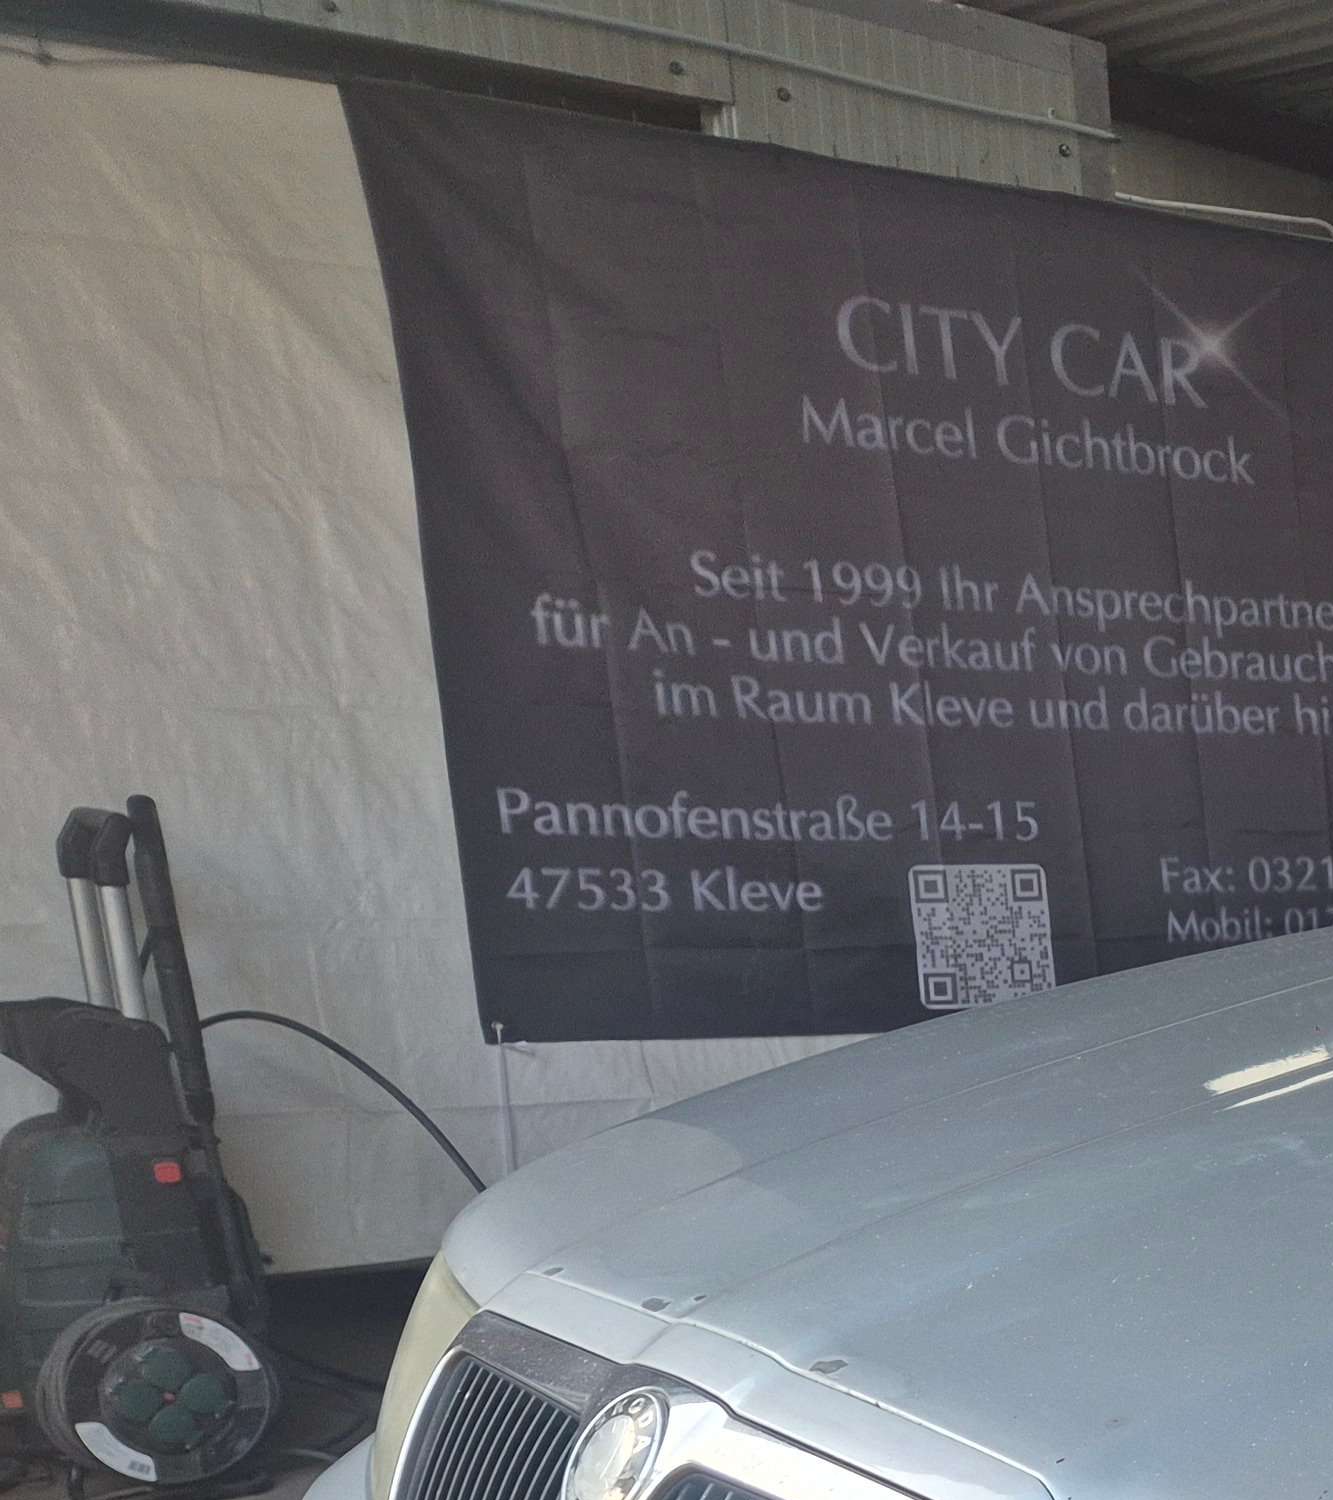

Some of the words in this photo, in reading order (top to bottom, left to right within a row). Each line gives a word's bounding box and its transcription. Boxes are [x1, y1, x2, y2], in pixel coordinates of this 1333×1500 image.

[836, 295, 1024, 386] CITY
[1049, 323, 1209, 408] CAR
[800, 393, 979, 460] Marcel
[995, 413, 1255, 486] Gichtbrock
[689, 550, 786, 602] Seit
[802, 558, 921, 610] 1999
[939, 564, 1001, 613] Ihr
[530, 592, 610, 649] für
[627, 605, 697, 656] An
[747, 616, 846, 666] und
[858, 622, 1037, 674] Verkauf
[1051, 641, 1129, 677] von
[652, 668, 717, 718] im
[730, 674, 873, 724] Raum
[888, 681, 1015, 730] Kleve
[1028, 686, 1109, 733] und
[1123, 689, 1280, 738] darüber
[495, 787, 895, 843] Pannofenstraße
[910, 799, 1040, 843] 14-15
[505, 867, 671, 913] 47533
[690, 865, 825, 914] Kleve
[1159, 855, 1236, 896] Fax:
[1166, 906, 1274, 944] Mobil:
